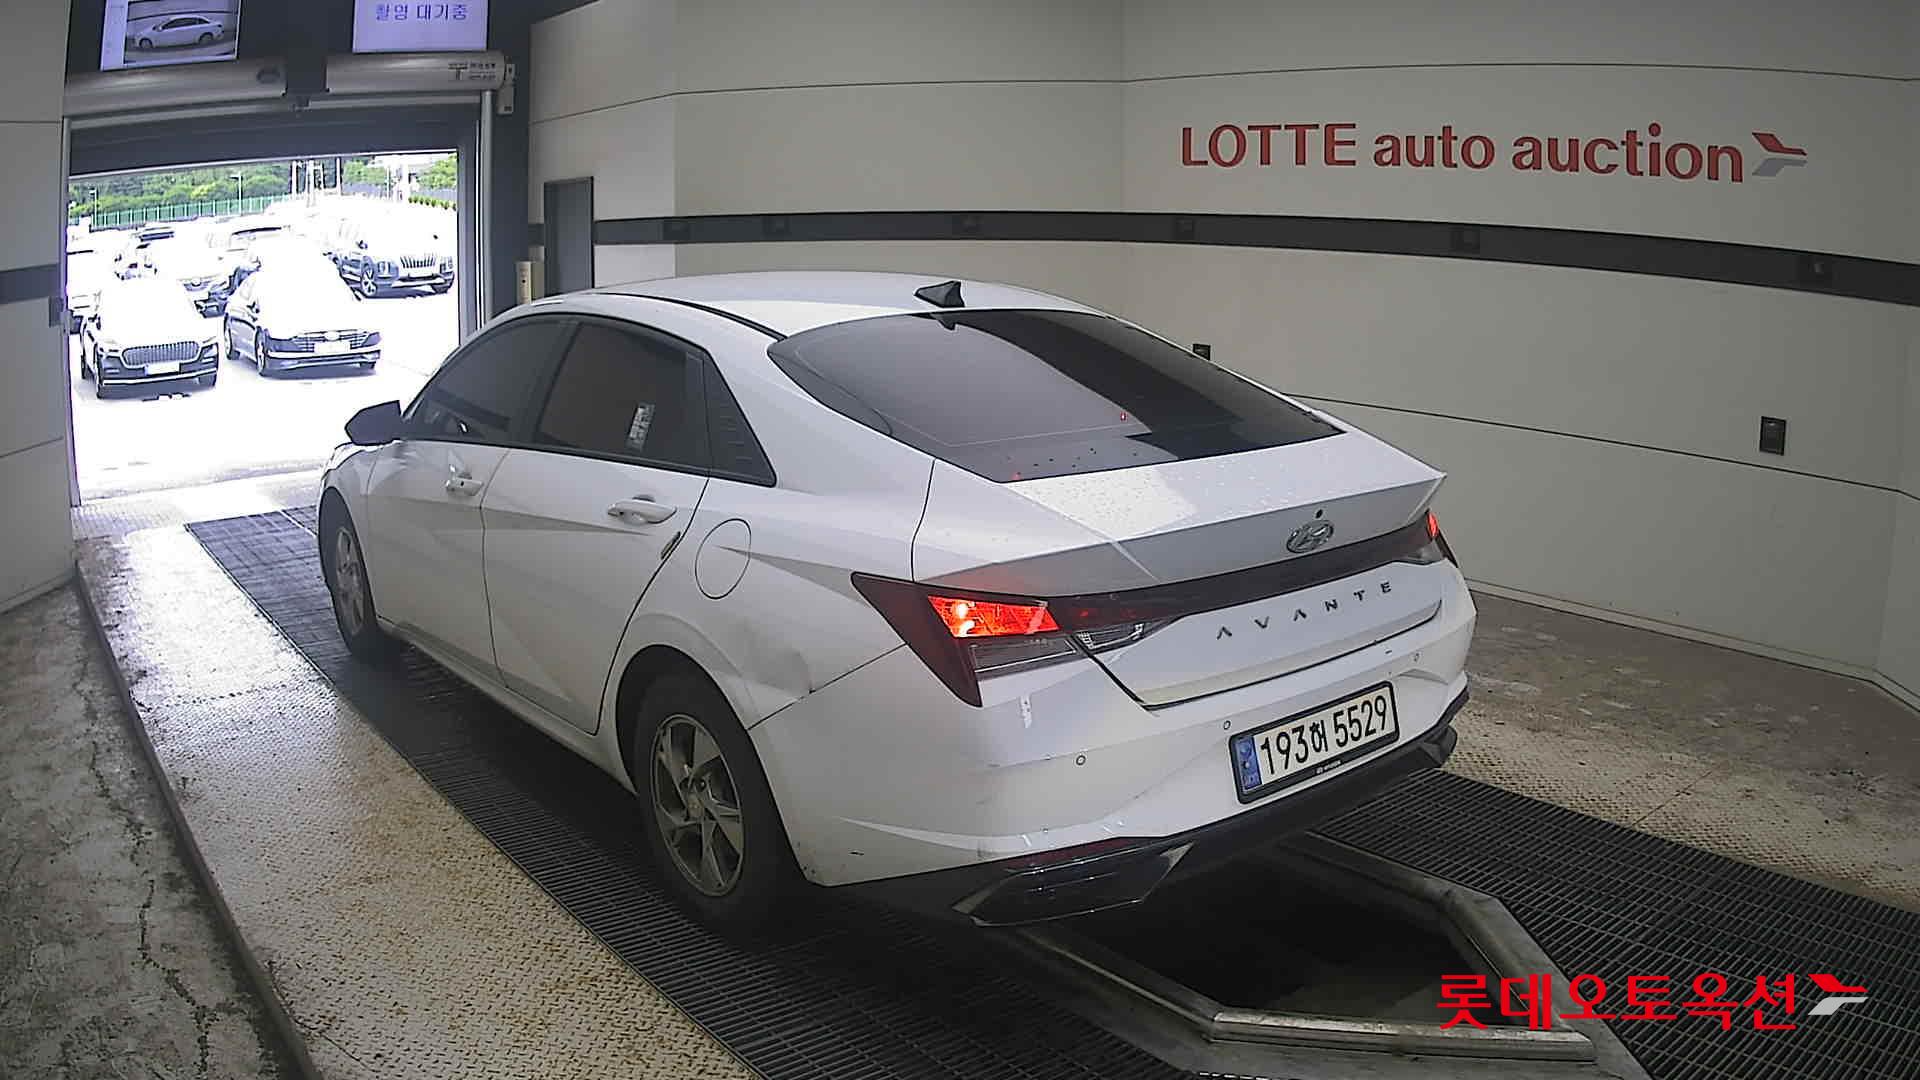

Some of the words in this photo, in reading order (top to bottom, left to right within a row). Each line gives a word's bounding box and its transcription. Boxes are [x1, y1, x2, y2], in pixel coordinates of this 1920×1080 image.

[416, 3, 468, 21] 대기중
[1182, 122, 1357, 168] LOTTE
[1374, 127, 1496, 170] auto
[1513, 122, 1744, 183] auction
[1216, 581, 1392, 640] AVANTE
[1260, 718, 1329, 776] 193허
[1332, 694, 1388, 750] 5529
